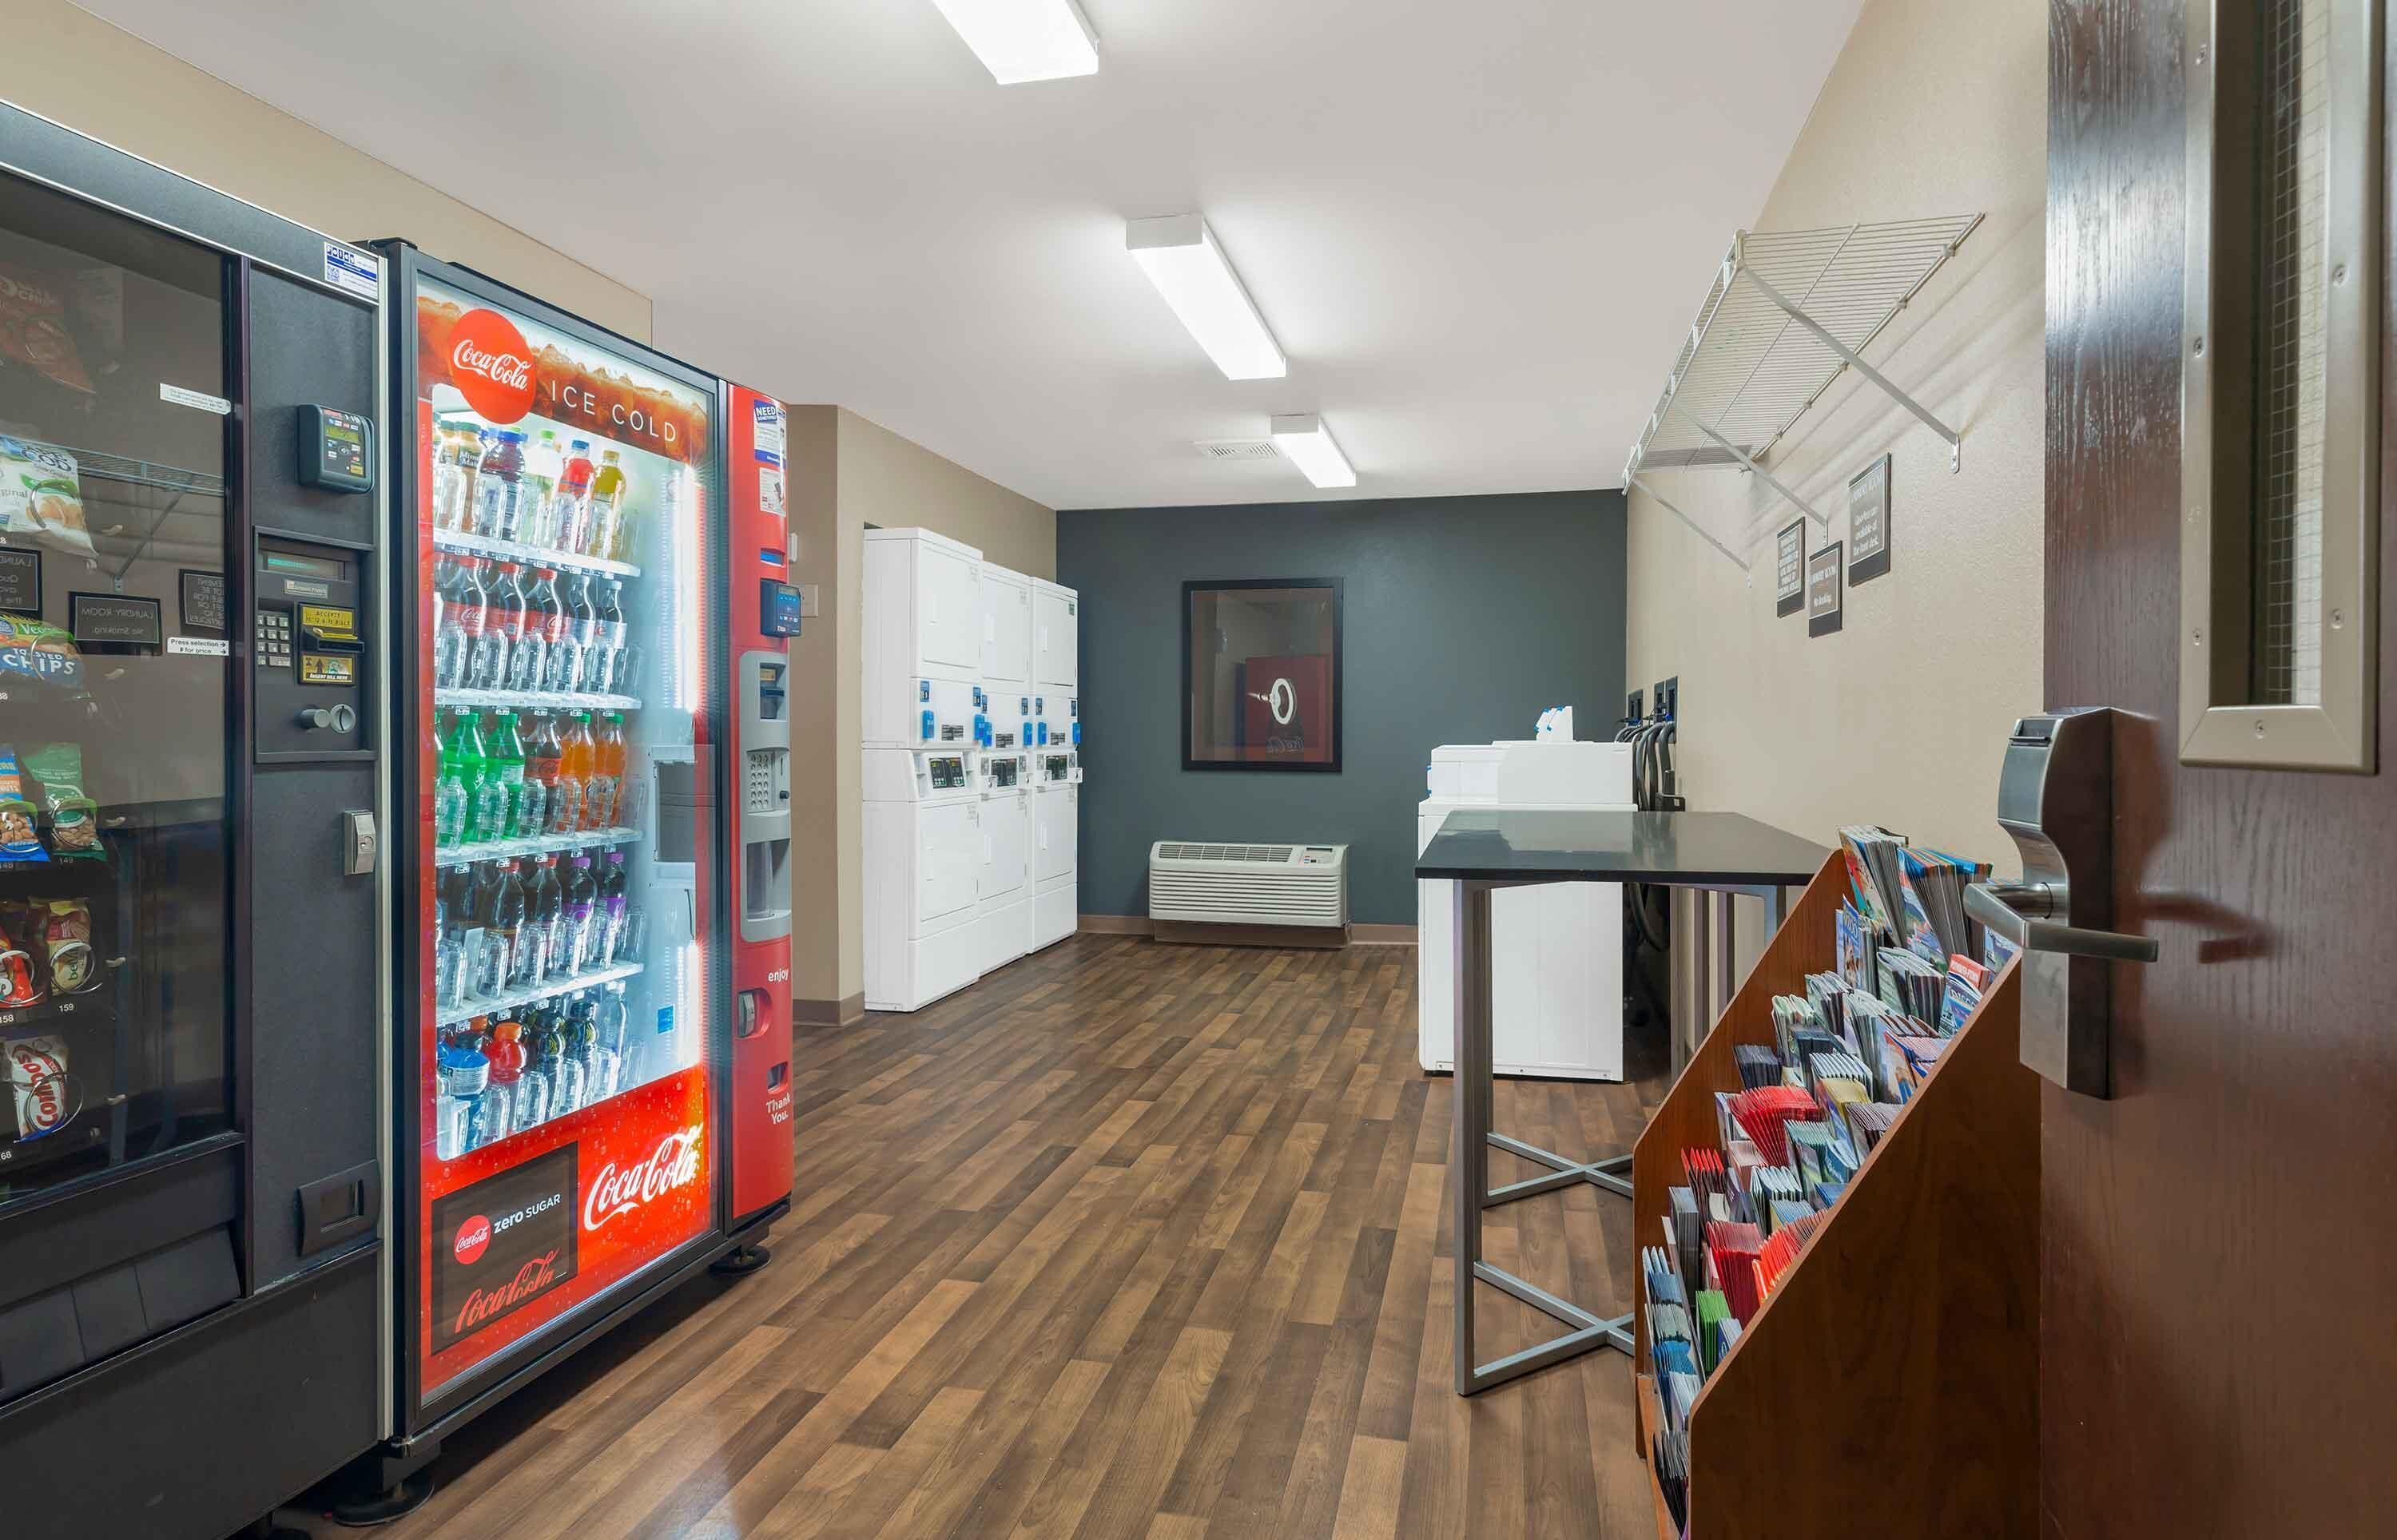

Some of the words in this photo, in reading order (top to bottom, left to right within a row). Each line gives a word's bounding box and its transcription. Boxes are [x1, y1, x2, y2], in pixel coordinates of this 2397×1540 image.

[453, 339, 531, 391] Coca-Cola
[551, 379, 596, 416] ICE
[612, 404, 677, 442] COLD
[755, 406, 776, 416] NEED
[768, 967, 789, 983] enjoy
[58, 1003, 75, 1012] 159
[765, 1091, 791, 1113] Thank
[770, 1112, 789, 1125] You.
[584, 1121, 704, 1231] Coca-Cola
[493, 1210, 524, 1234] zero
[526, 1193, 562, 1219] SUGAR
[455, 1226, 488, 1253] Coca-Cola
